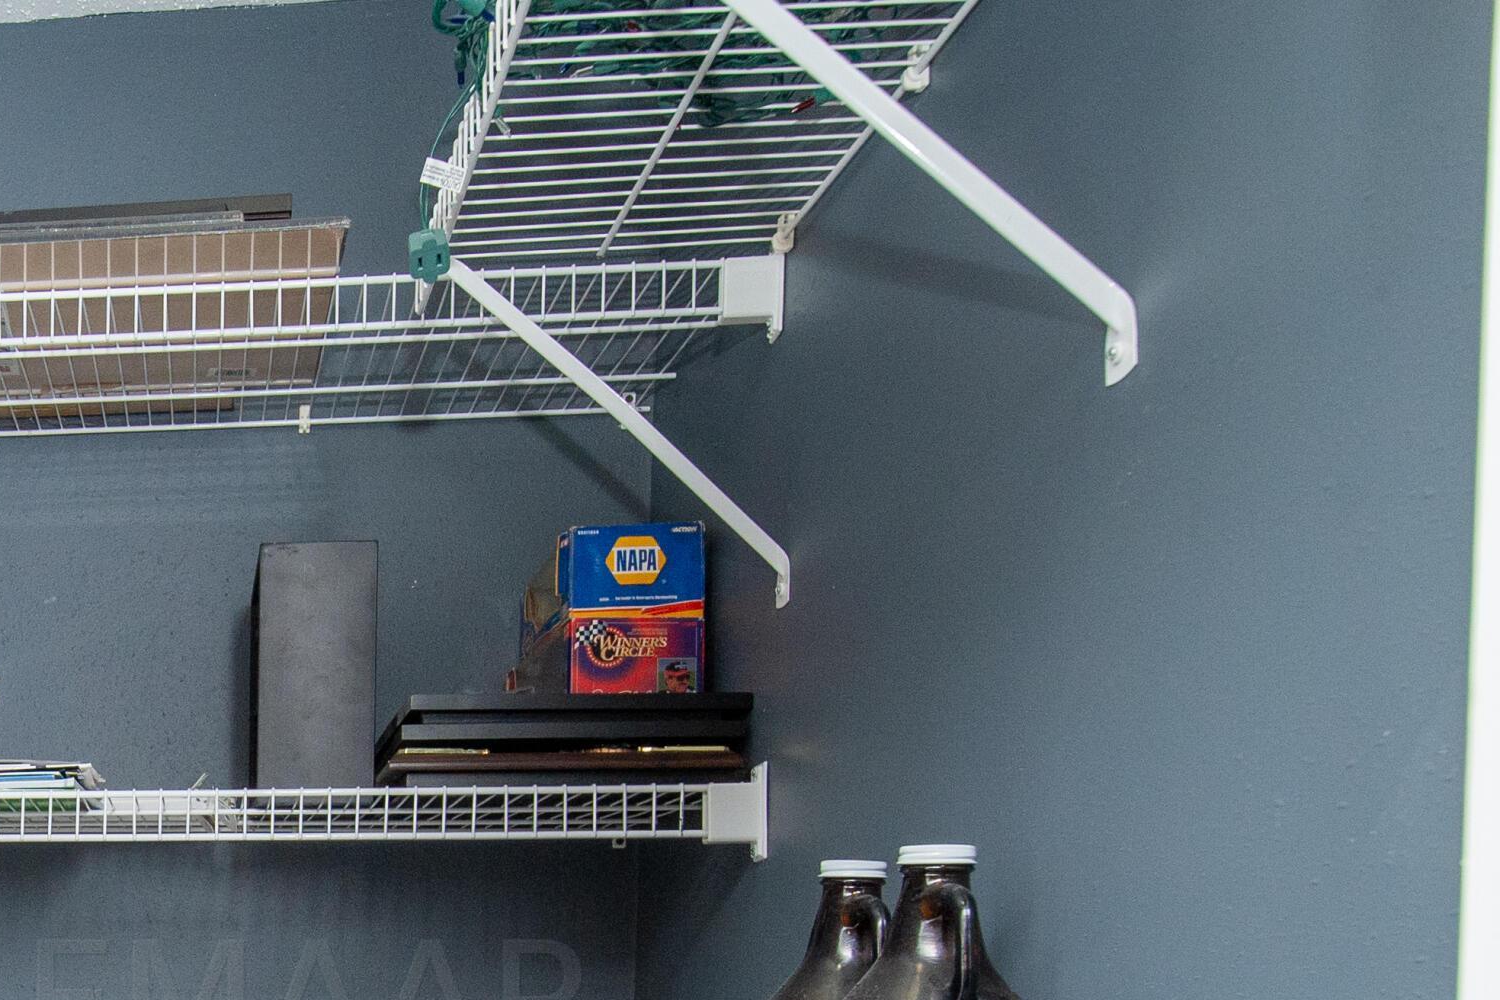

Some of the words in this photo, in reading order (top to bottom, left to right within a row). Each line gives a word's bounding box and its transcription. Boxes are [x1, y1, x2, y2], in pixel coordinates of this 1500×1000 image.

[616, 550, 657, 572] NAPA
[593, 634, 668, 649] WINNER'S
[600, 646, 655, 662] CIRCLE
